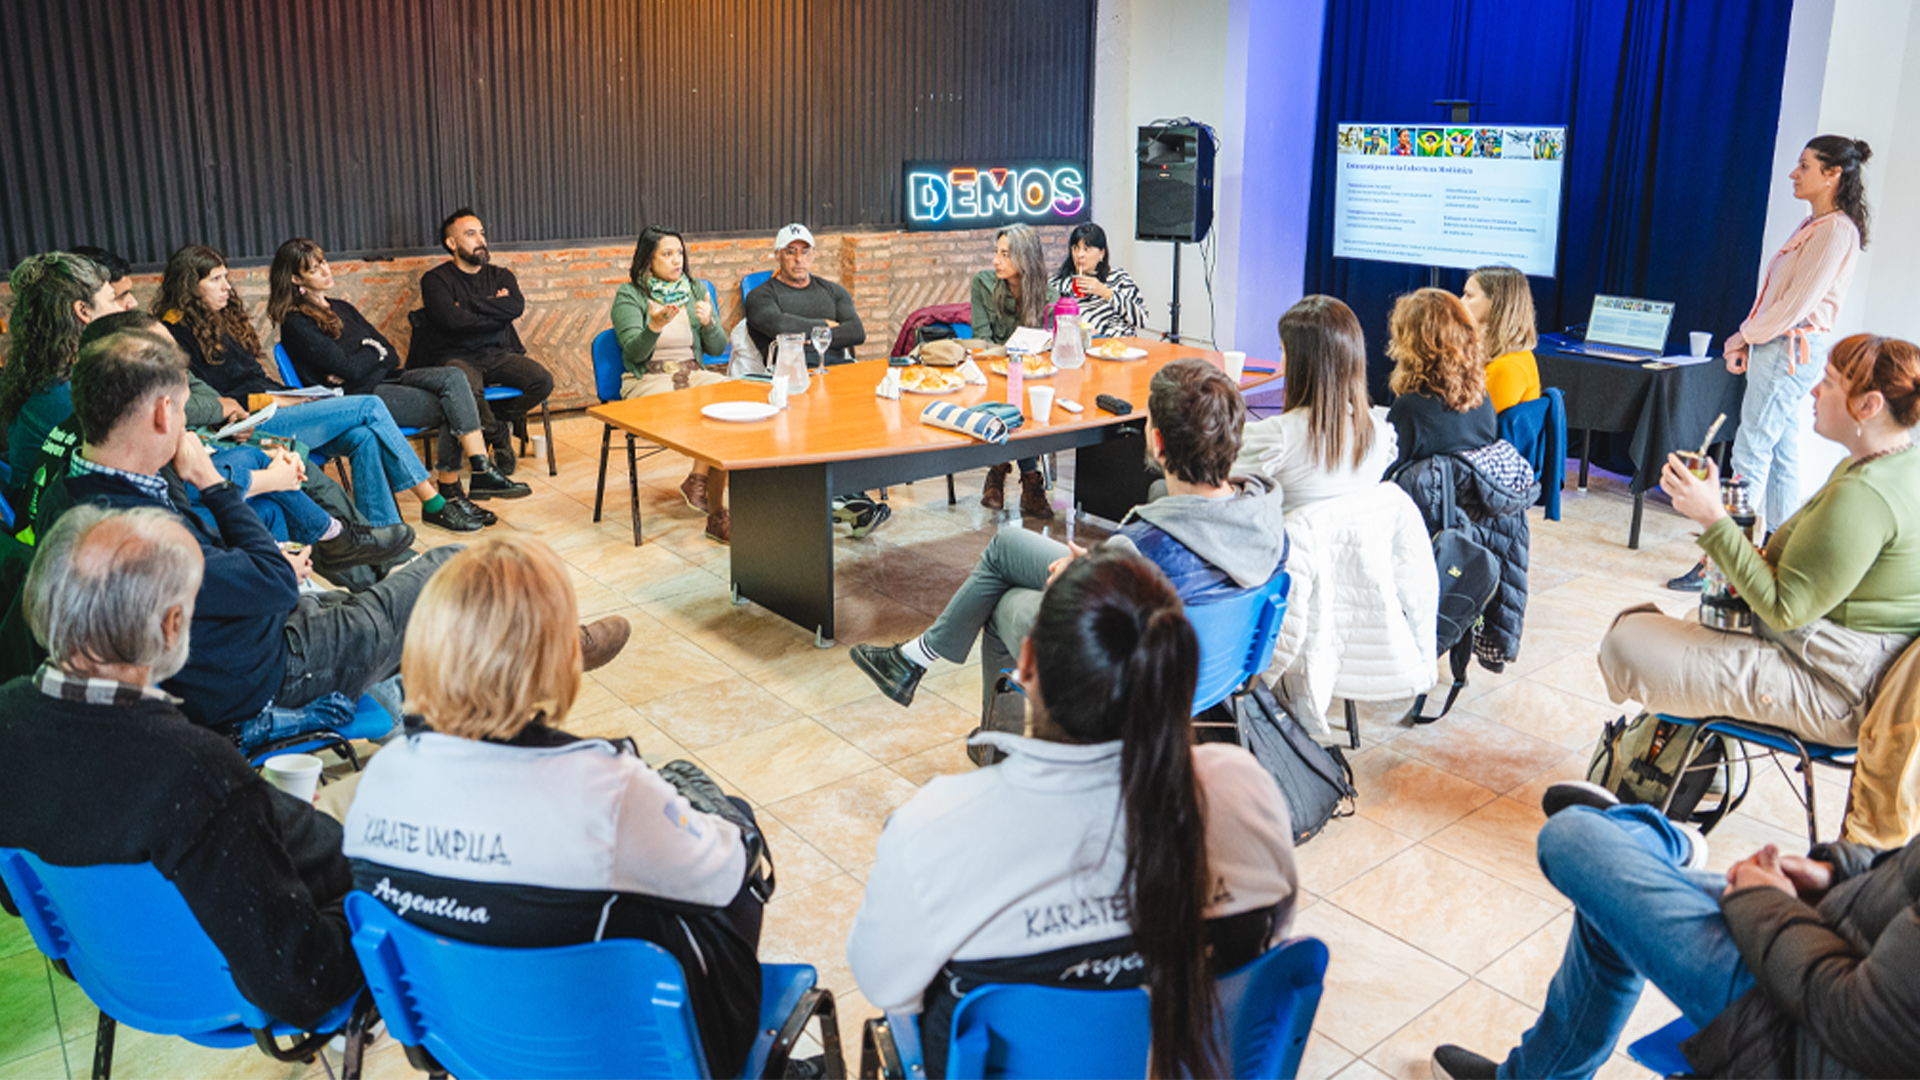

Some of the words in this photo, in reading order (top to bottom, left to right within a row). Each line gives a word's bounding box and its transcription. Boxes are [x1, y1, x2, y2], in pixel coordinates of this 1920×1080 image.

[909, 167, 1085, 221] DEMOS
[371, 876, 491, 924] Argentina
[1024, 894, 1131, 938] KARATE
